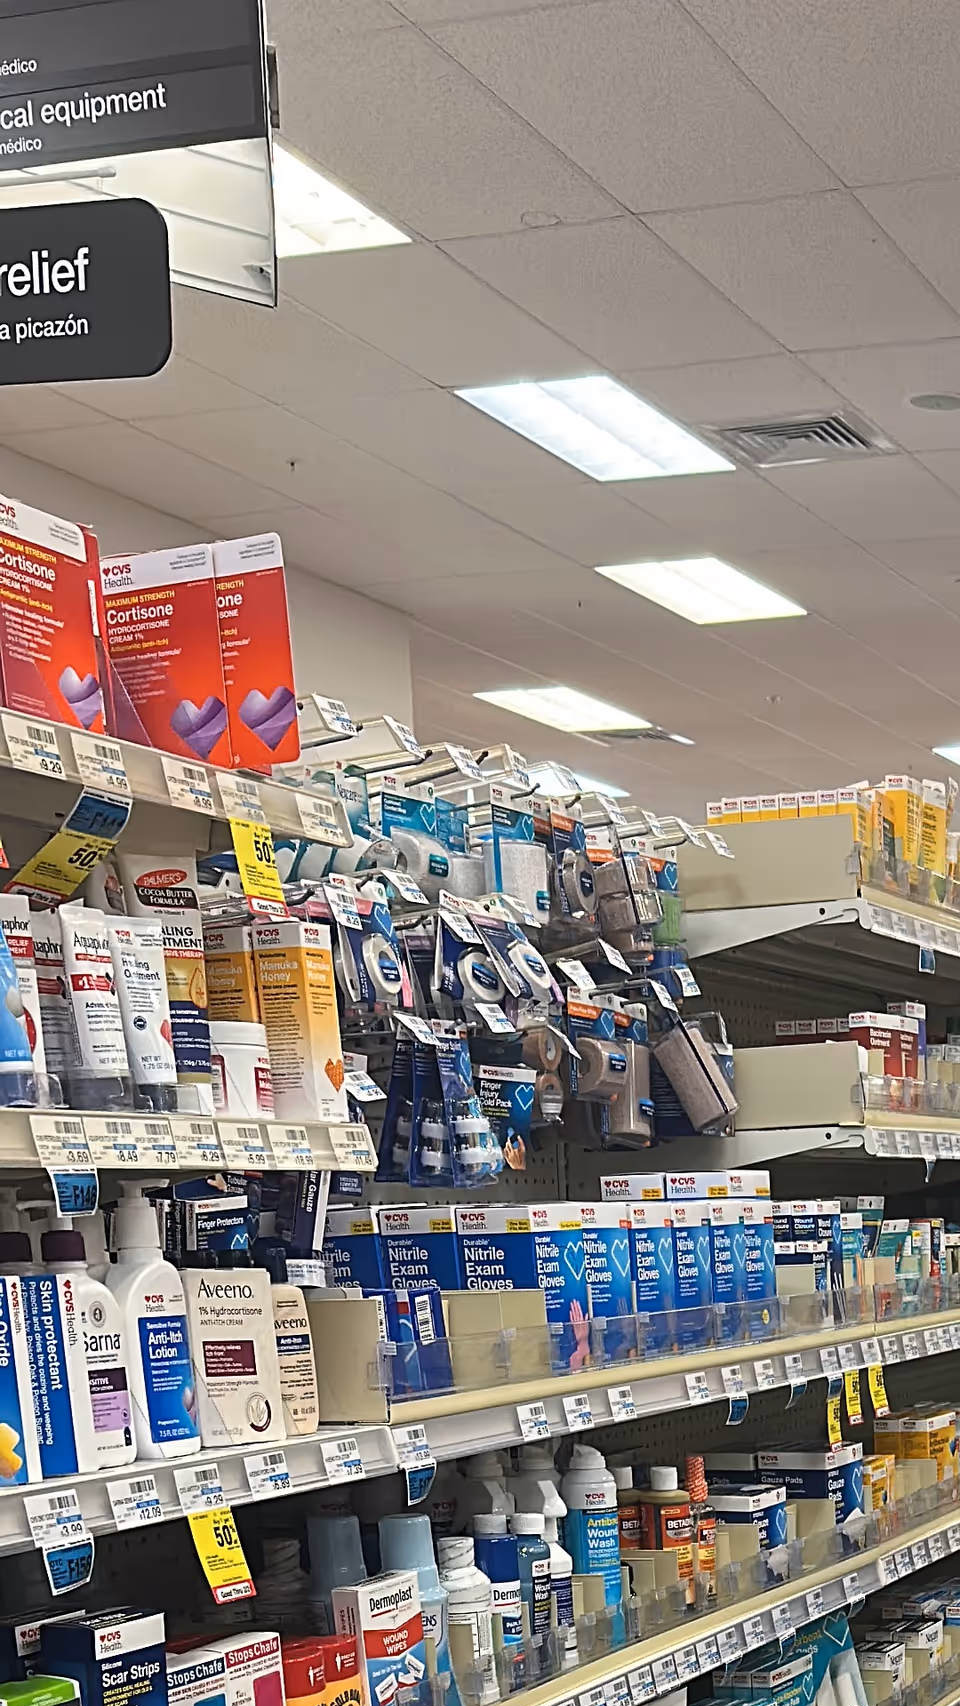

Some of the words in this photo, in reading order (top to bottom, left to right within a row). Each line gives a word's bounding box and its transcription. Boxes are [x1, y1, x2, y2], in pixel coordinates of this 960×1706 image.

[41, 82, 167, 128] equipment
[15, 313, 89, 344] picazón
[25, 546, 57, 564] STRENGTH
[111, 563, 132, 576] CVS
[105, 596, 139, 608] MAXIMUM
[139, 590, 175, 603] STRENGTH
[106, 602, 174, 626] Cortisone
[108, 619, 170, 637] HYDROCORTISONE
[109, 634, 133, 645] CREAM
[143, 873, 182, 886] PALMER'S
[138, 887, 165, 898] COCOA
[166, 889, 193, 899] BUTTER
[259, 959, 299, 972] Manuka
[260, 971, 291, 984] Honey
[480, 1080, 501, 1091] Finger
[480, 1090, 500, 1099] Injury
[197, 1219, 216, 1231] Finger
[216, 1215, 244, 1227] Protectors
[393, 1213, 409, 1222] CVS
[468, 1212, 486, 1222] CVS
[389, 1247, 429, 1260] Nitrile
[464, 1247, 505, 1260] Nitrile
[535, 1244, 560, 1258] Nitrile
[390, 1261, 429, 1275] Exam
[466, 1262, 505, 1276] Exam
[537, 1259, 560, 1273] Exam
[392, 1276, 438, 1289] Gloves
[467, 1276, 514, 1290] Gloves
[538, 1274, 566, 1288] Gloves
[197, 1278, 253, 1300] Aveeno
[40, 1280, 53, 1314] Skin
[209, 1306, 263, 1318] Hydrocortisone
[148, 1330, 183, 1345] Anti-Itch
[41, 1315, 63, 1391] protectant
[149, 1347, 178, 1360] Lotion
[587, 1528, 618, 1540] Wound
[588, 1538, 616, 1549] Wash
[368, 1584, 415, 1613] Dermoplast
[382, 1629, 409, 1647] WOUND
[386, 1640, 408, 1656] WIPES
[102, 1669, 129, 1688] Scar
[130, 1661, 161, 1683] Strips
[166, 1670, 196, 1688] Stops
[195, 1661, 224, 1680] Chafe
